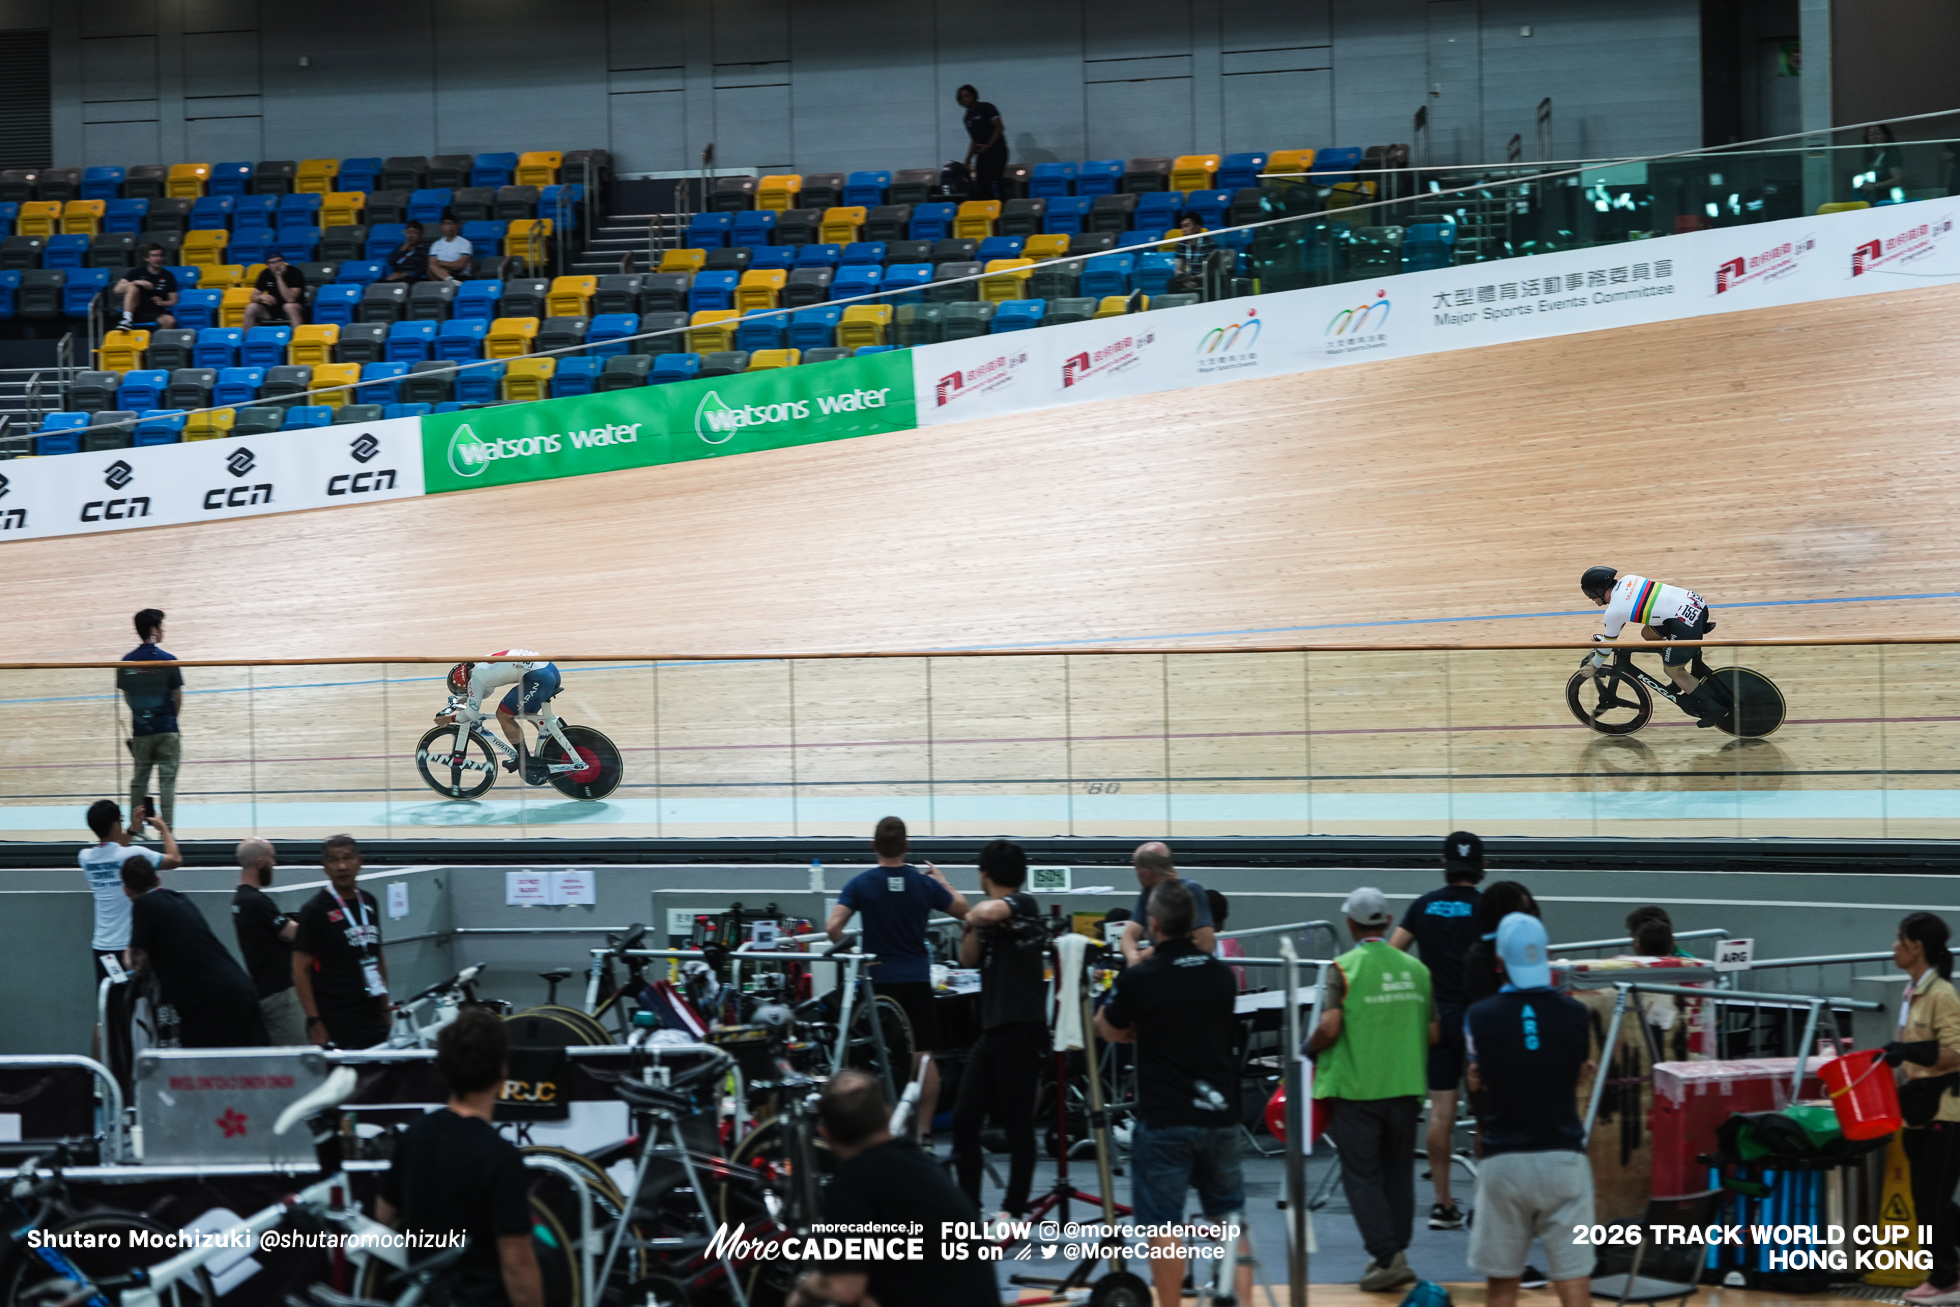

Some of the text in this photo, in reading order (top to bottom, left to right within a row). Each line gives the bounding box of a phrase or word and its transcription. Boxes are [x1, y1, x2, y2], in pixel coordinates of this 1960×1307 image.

[1432, 259, 1673, 309] 大型體育活動事務委員會
[1433, 284, 1675, 326] Major Sports Events Committee
[816, 387, 891, 415] water
[568, 423, 642, 449] water
[1681, 604, 1699, 622] 155
[516, 682, 540, 711] JAPAN
[1637, 673, 1677, 703] KOGA
[1521, 1003, 1540, 1051] ARG
